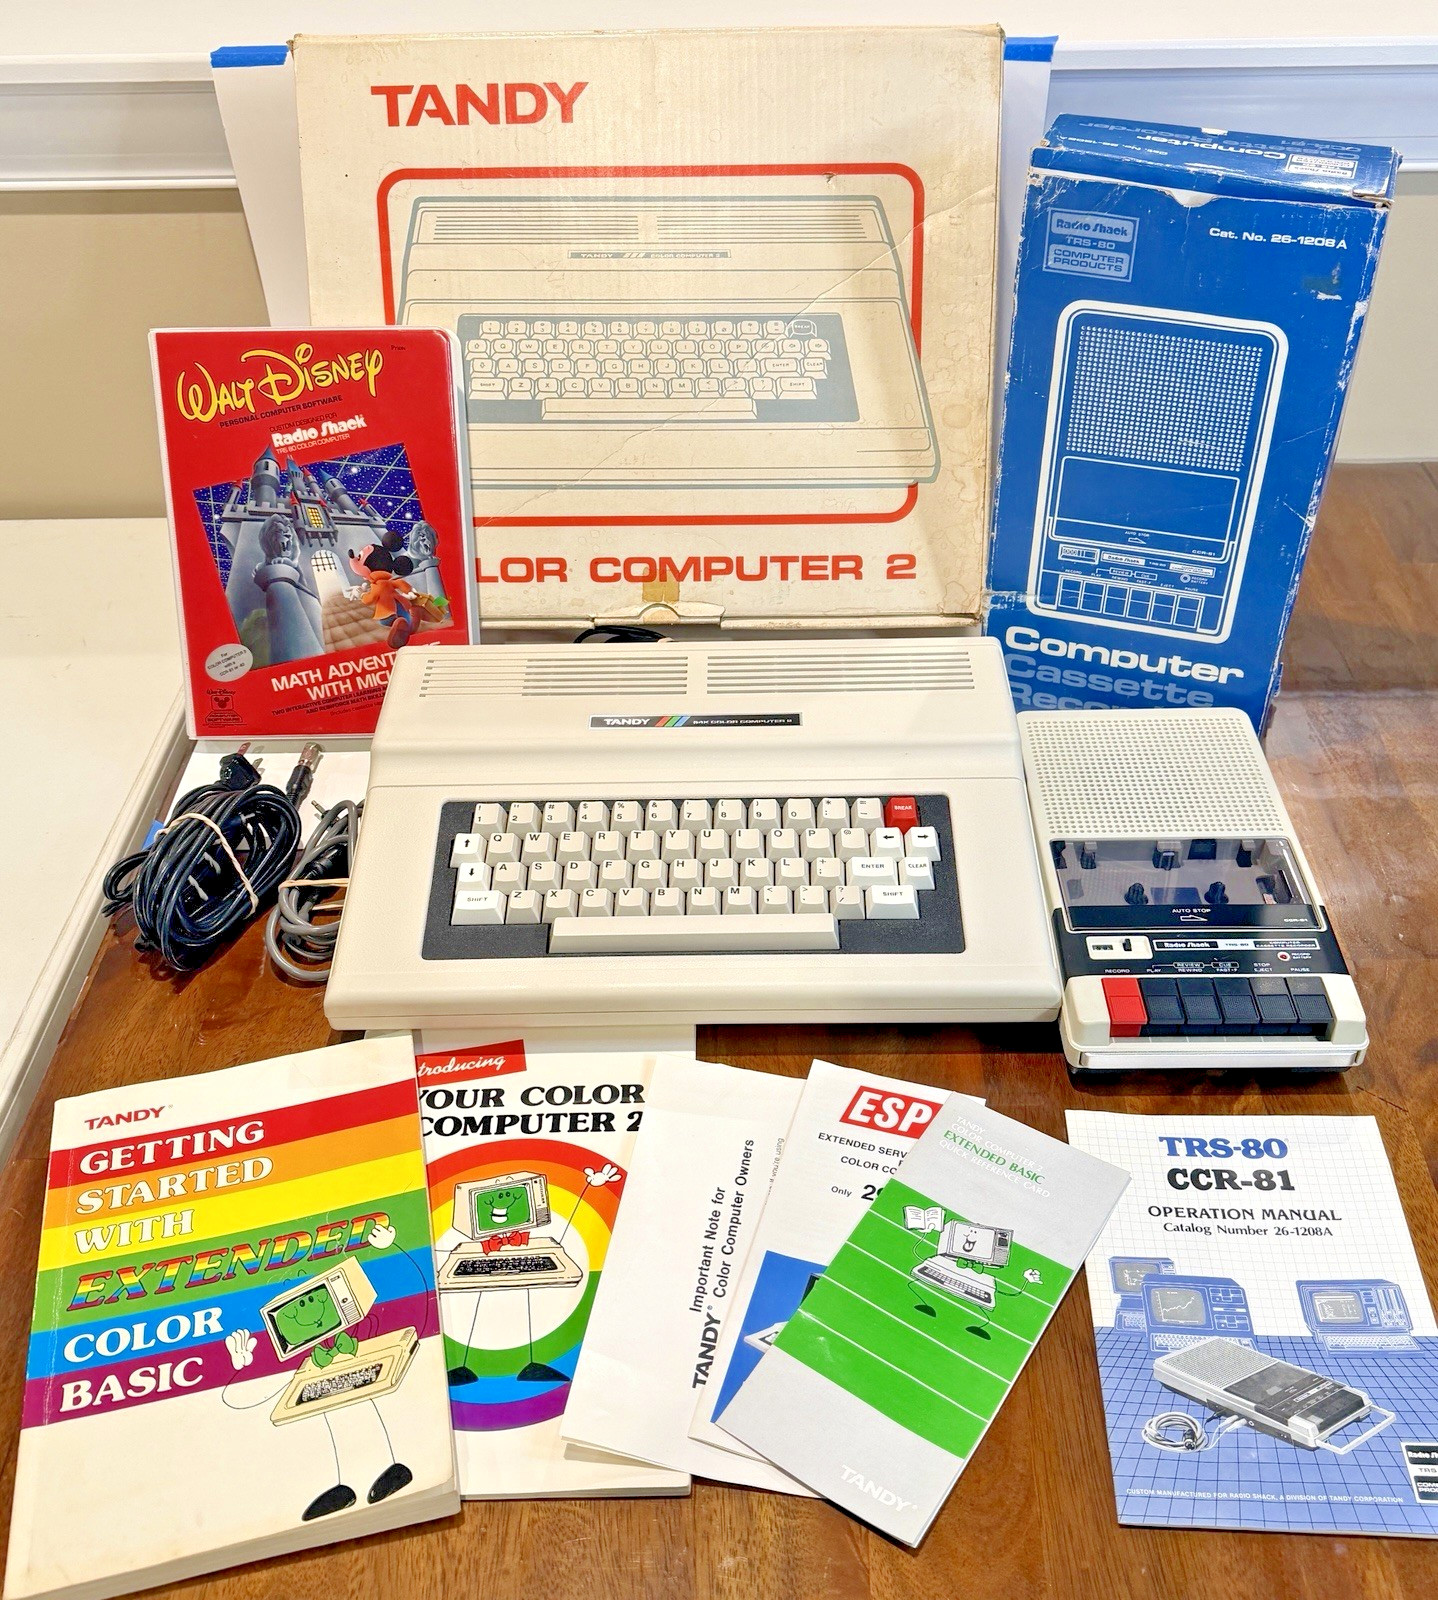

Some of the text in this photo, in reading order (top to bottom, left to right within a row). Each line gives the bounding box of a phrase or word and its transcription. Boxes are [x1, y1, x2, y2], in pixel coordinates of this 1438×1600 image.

[371, 82, 588, 127] TANDY
[1136, 135, 1286, 160] Computer
[1056, 219, 1128, 236] Radio Shack
[1209, 228, 1238, 240] Cat.
[1242, 232, 1267, 243] No.
[1066, 236, 1115, 250] TRS-80
[1053, 248, 1124, 264] COMPUTER
[1053, 257, 1123, 272] PRODUCTS
[220, 394, 343, 428] PERSONAL COMPUTER SOFTWARE
[269, 412, 337, 432] CUSTOM DESIGNED FOR
[271, 415, 368, 448] Radio Shack
[297, 440, 318, 451] COLOR
[318, 433, 351, 446] COMPUTER
[589, 555, 863, 583] COMPUTER
[886, 554, 917, 580] 2
[1005, 625, 1245, 684] Computer
[271, 650, 398, 693] MATH ADVENT
[1004, 653, 1214, 708] Cassette
[306, 680, 353, 701] WITH
[322, 693, 352, 705] COMPUTER
[604, 718, 650, 726] TANDY
[493, 834, 502, 842] Q
[563, 833, 571, 841] E
[598, 832, 606, 840] R
[549, 890, 558, 898] X
[586, 889, 594, 897] C
[520, 1084, 645, 1106] COLOR
[84, 1105, 166, 1131] TANDY
[626, 1111, 643, 1132] 2
[848, 1090, 934, 1133] ESP
[957, 1116, 985, 1134] TANDY
[79, 1120, 266, 1175] GETTING
[818, 1132, 876, 1152] EXTENDED
[951, 1123, 983, 1144] COLOR
[984, 1140, 1036, 1169] COMPUTER
[1158, 1136, 1289, 1160] TRS-80
[840, 1156, 880, 1171] COLOR
[943, 1130, 1046, 1185] EXTENDED BASIC
[940, 1140, 1051, 1198] QUICK REFERENCE CARD
[1167, 1168, 1295, 1191] CCR-81
[75, 1156, 275, 1215] STARTED
[831, 1184, 884, 1201] Only 2
[1148, 1205, 1342, 1221] OPERATION MANUAL
[74, 1208, 195, 1254] WITH
[1163, 1222, 1333, 1237] Catalog Number 26-1208A
[689, 1187, 726, 1313] Important Note for
[66, 1212, 391, 1312] EXTENDED
[692, 1139, 754, 1389] TANDY Color Computer Owners
[63, 1307, 225, 1363] COLOR
[59, 1356, 204, 1413] BASIC
[840, 1464, 912, 1512] TANDY
[1156, 1490, 1212, 1498] MANUFACTURED
